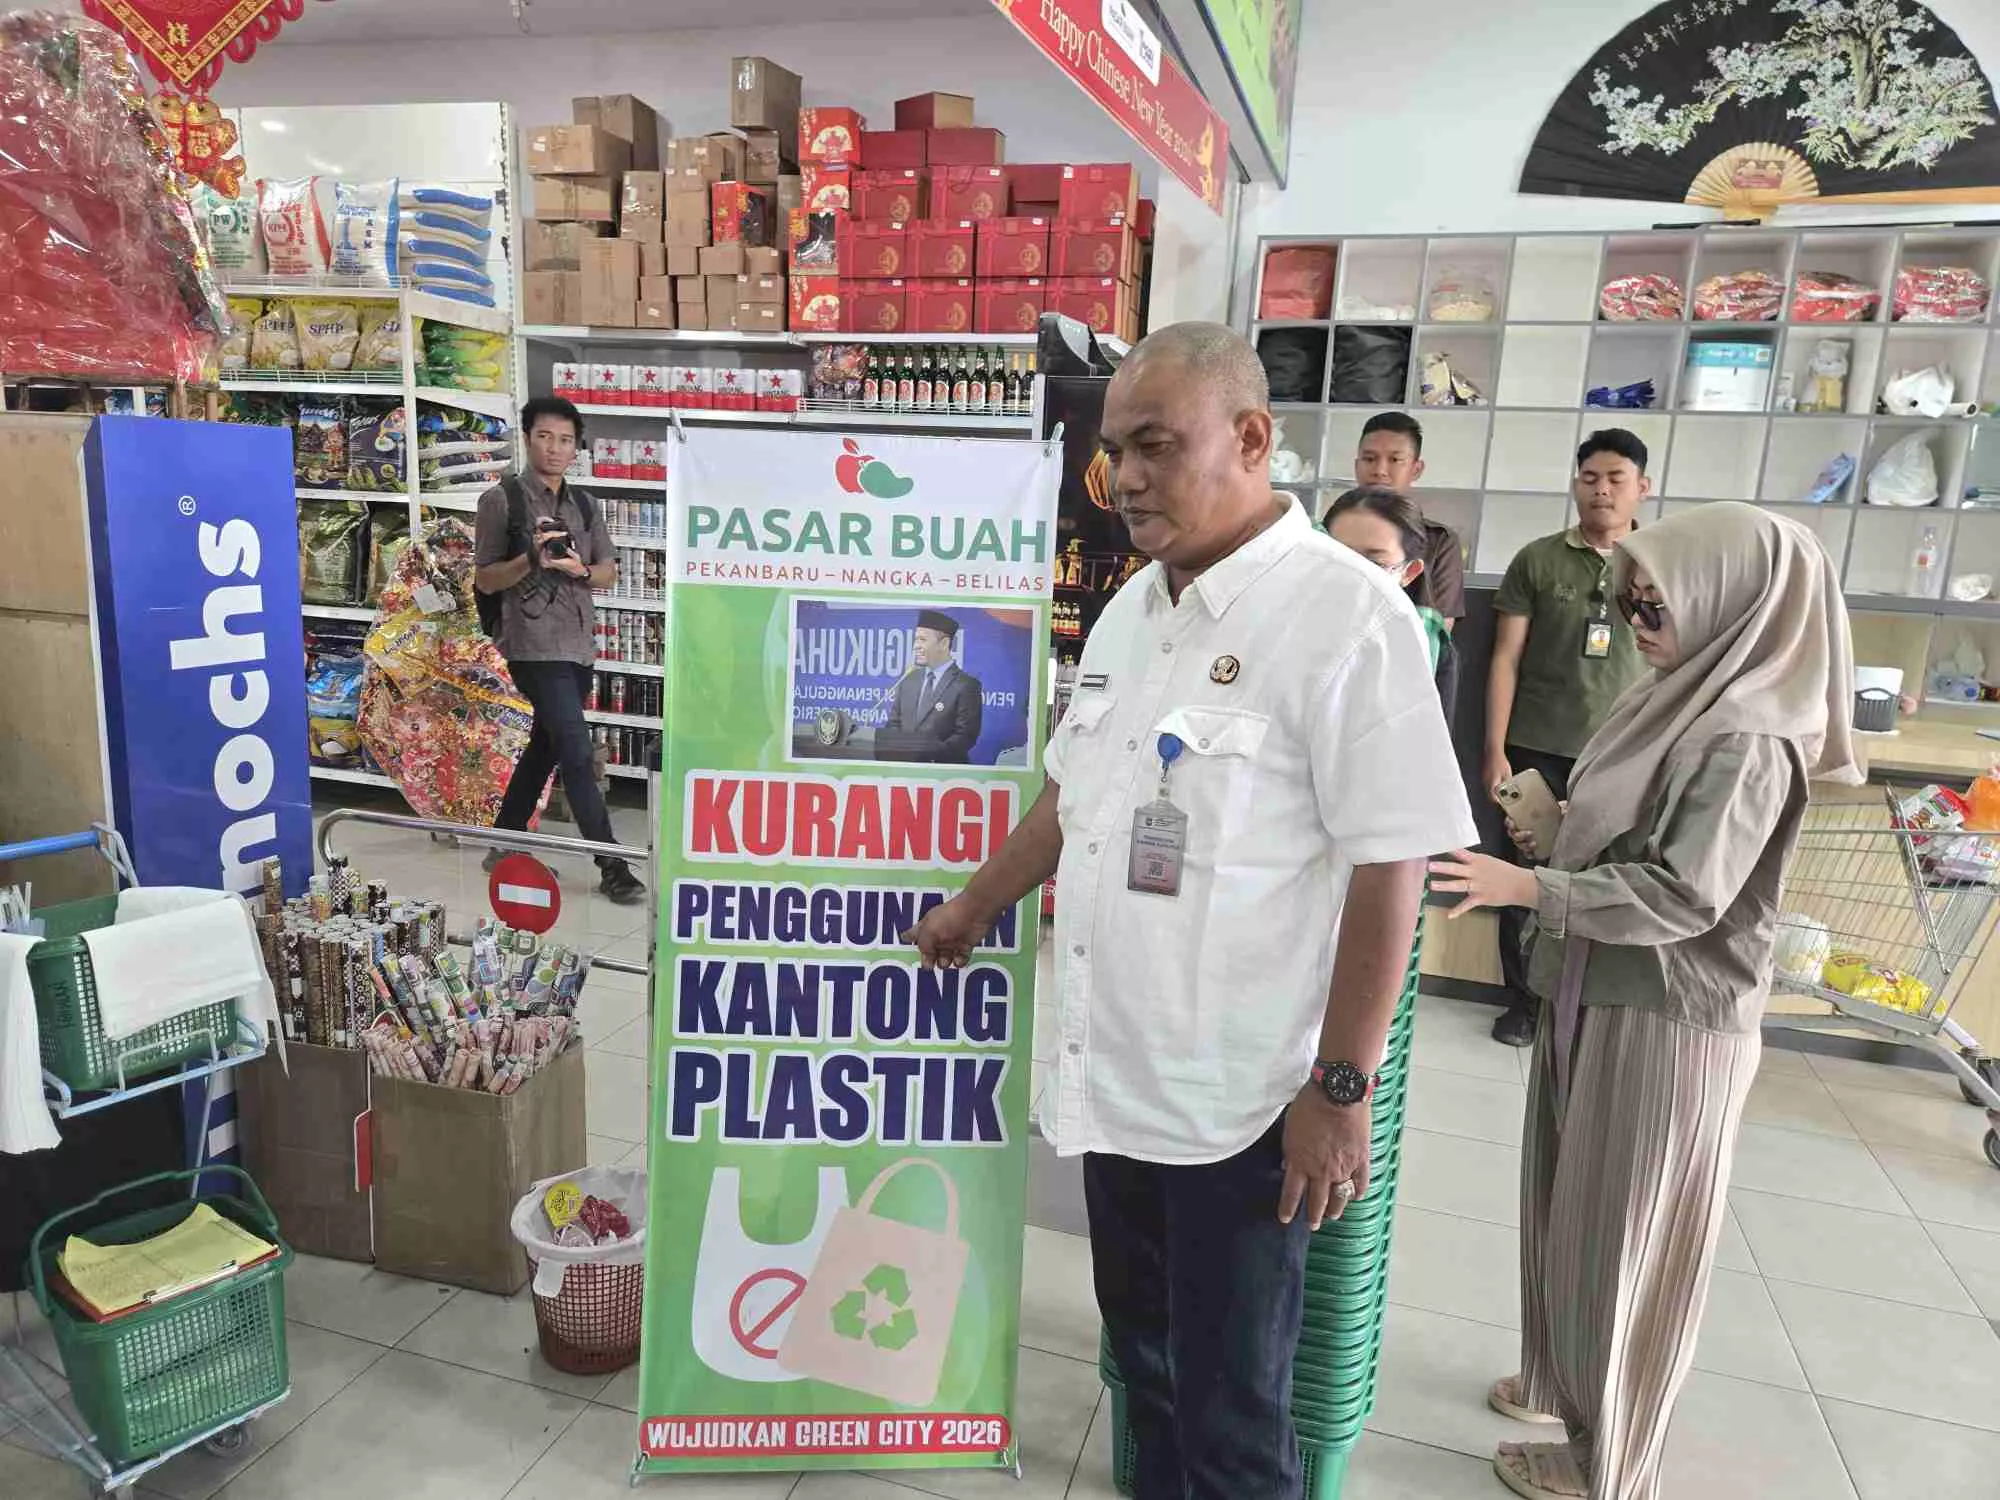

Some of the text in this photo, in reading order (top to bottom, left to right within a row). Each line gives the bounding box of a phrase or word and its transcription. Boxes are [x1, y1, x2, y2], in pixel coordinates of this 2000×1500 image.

[1087, 30, 1131, 104] Chinese
[686, 504, 1048, 564] PASAR BUAH
[686, 561, 819, 582] PEKANBARU
[841, 568, 933, 587] NANGKA
[956, 573, 1045, 592] BELILAS
[169, 518, 277, 908] nochs
[691, 777, 1011, 863] KURANGI
[678, 959, 1008, 1043] KANTONG
[671, 1051, 1006, 1142] PLASTIK
[647, 1419, 1001, 1449] WUJUDKAN GREEN CITY 2026
